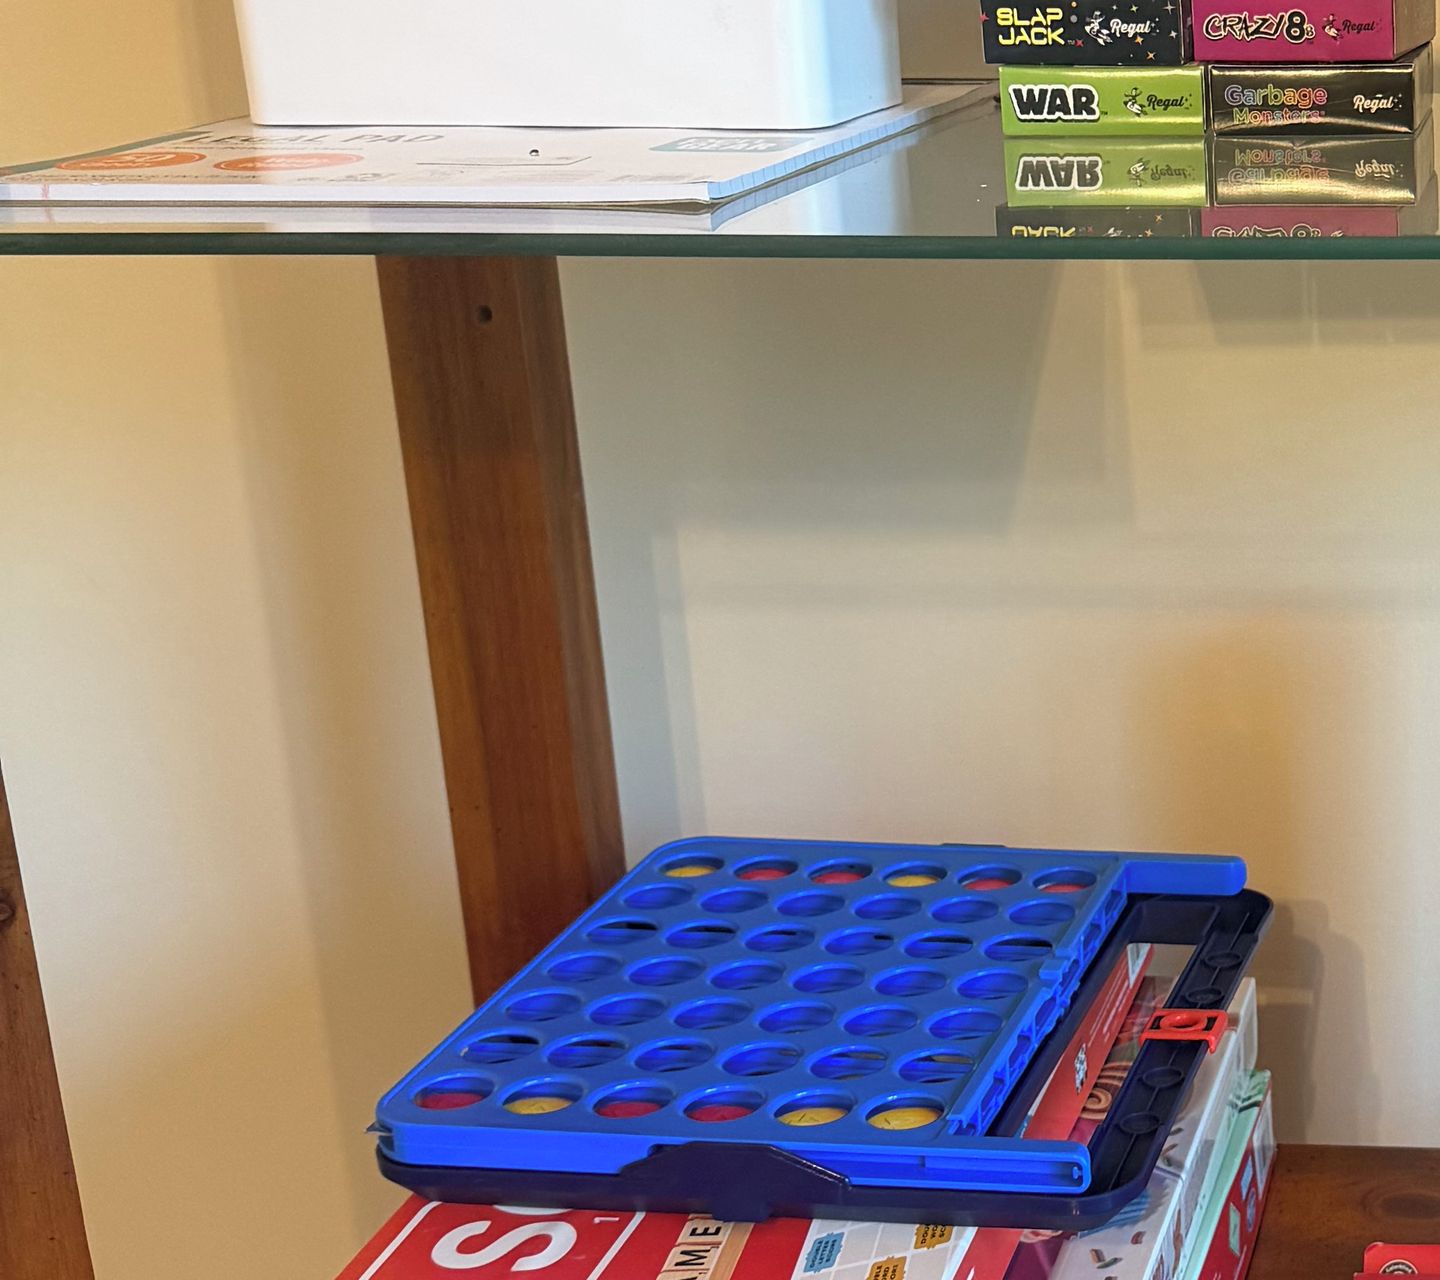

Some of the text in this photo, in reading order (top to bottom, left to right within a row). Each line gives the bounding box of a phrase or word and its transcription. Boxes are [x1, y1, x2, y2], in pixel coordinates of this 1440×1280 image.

[995, 7, 1063, 27] SLAP
[1341, 19, 1376, 34] Regal
[998, 26, 1066, 47] JACK
[1109, 18, 1151, 38] Regal
[1012, 87, 1098, 119] WAR
[1146, 92, 1185, 113] Regal
[1224, 84, 1328, 107] Garbage
[1353, 94, 1396, 113] Regal
[1233, 107, 1322, 125] Monsters
